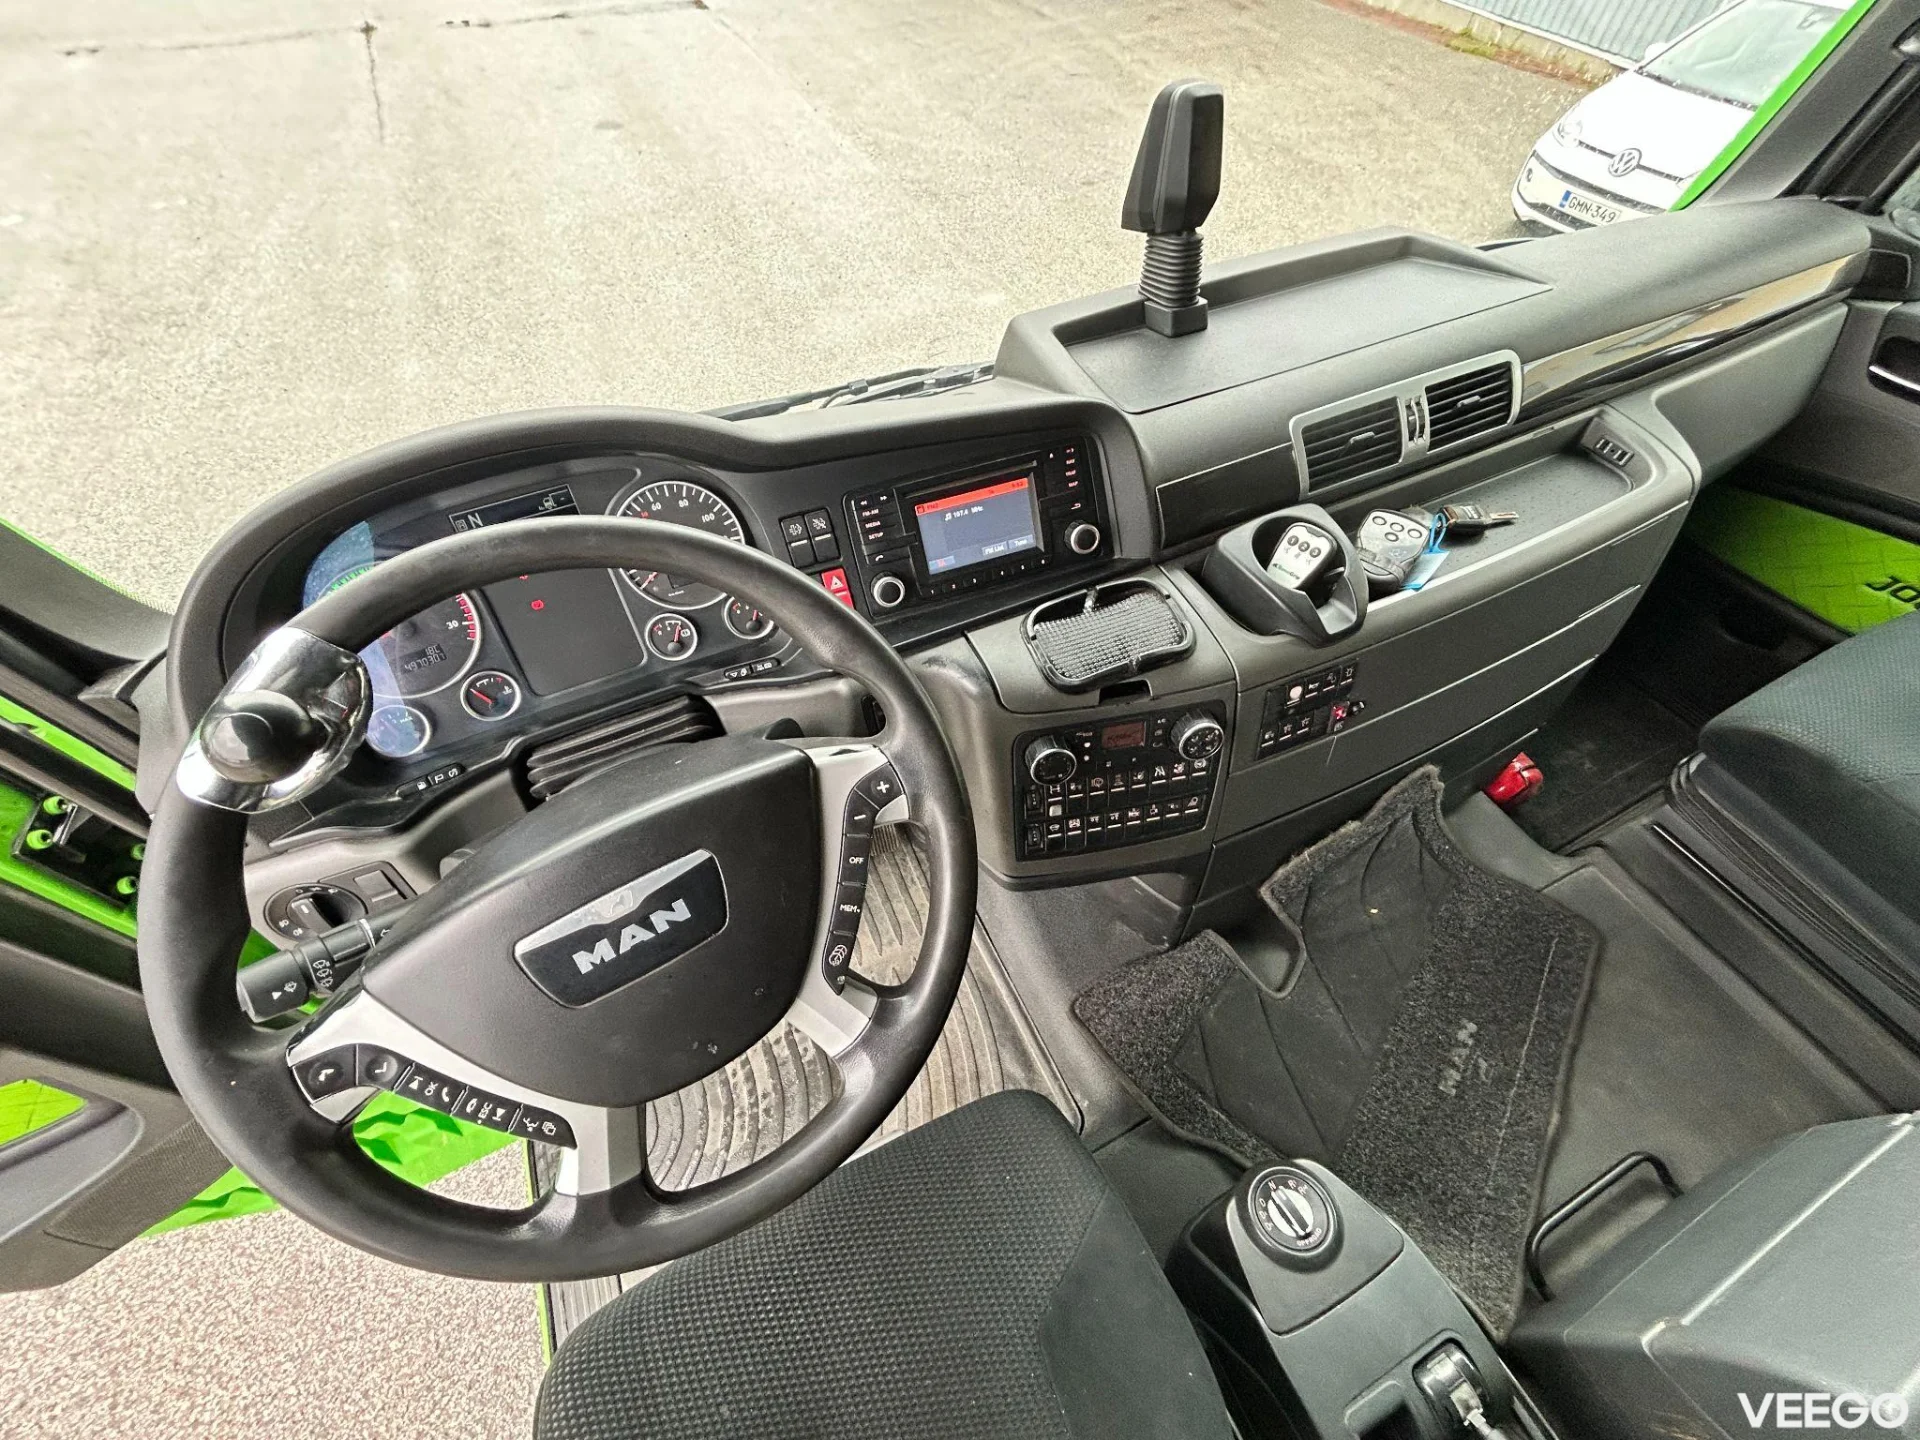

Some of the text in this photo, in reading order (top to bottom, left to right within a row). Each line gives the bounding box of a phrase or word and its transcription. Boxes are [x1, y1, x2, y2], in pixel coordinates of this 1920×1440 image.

[1568, 196, 1617, 223] GMN-349
[651, 502, 662, 511] 60
[678, 499, 689, 508] 80
[467, 512, 484, 529] N
[701, 512, 716, 523] 100
[445, 619, 460, 630] 30
[849, 856, 865, 865] OFF
[572, 898, 692, 975] MAN
[424, 1081, 439, 1096] OK
[478, 1102, 493, 1119] ESC
